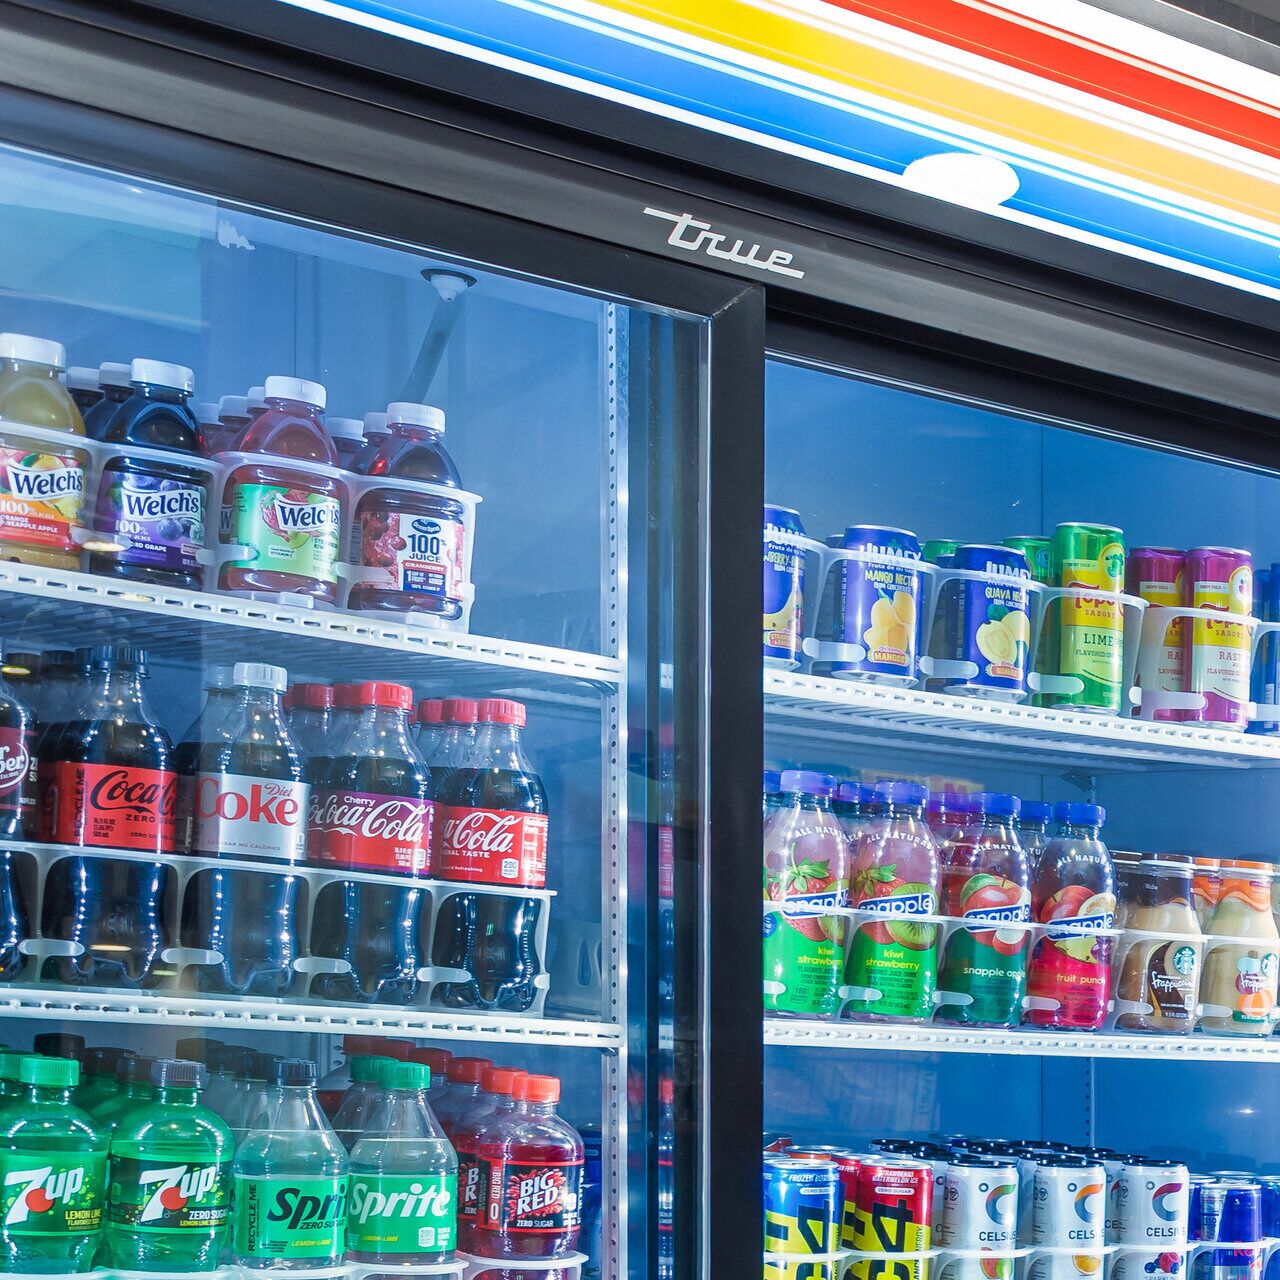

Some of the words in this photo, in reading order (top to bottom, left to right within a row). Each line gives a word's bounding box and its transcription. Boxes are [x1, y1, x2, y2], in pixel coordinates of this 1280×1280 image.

[643, 207, 805, 279] true
[13, 470, 83, 496] Welch's
[125, 493, 199, 517] Welch's
[409, 555, 441, 564] JUICE
[405, 562, 445, 573] CRANBERRY
[865, 569, 893, 583] MANGO
[985, 588, 1011, 600] GUAVA
[1083, 633, 1114, 647] LIME
[264, 783, 293, 797] Diet
[344, 795, 376, 807] Cherry
[126, 814, 155, 823] ZERO
[462, 850, 490, 859] TASTE
[883, 949, 904, 959] kiwi
[865, 958, 920, 971] strawberry
[964, 966, 1005, 979] snapple
[1056, 972, 1076, 985] fruit
[520, 1171, 554, 1197] BIG
[350, 1183, 450, 1225] Sprite
[516, 1187, 558, 1216] RED
[188, 1210, 209, 1219] ZERO
[249, 1203, 257, 1252] RECYCLE
[300, 1221, 323, 1230] ZERO
[516, 1219, 533, 1227] ZERO
[533, 1220, 554, 1228] SUGAR
